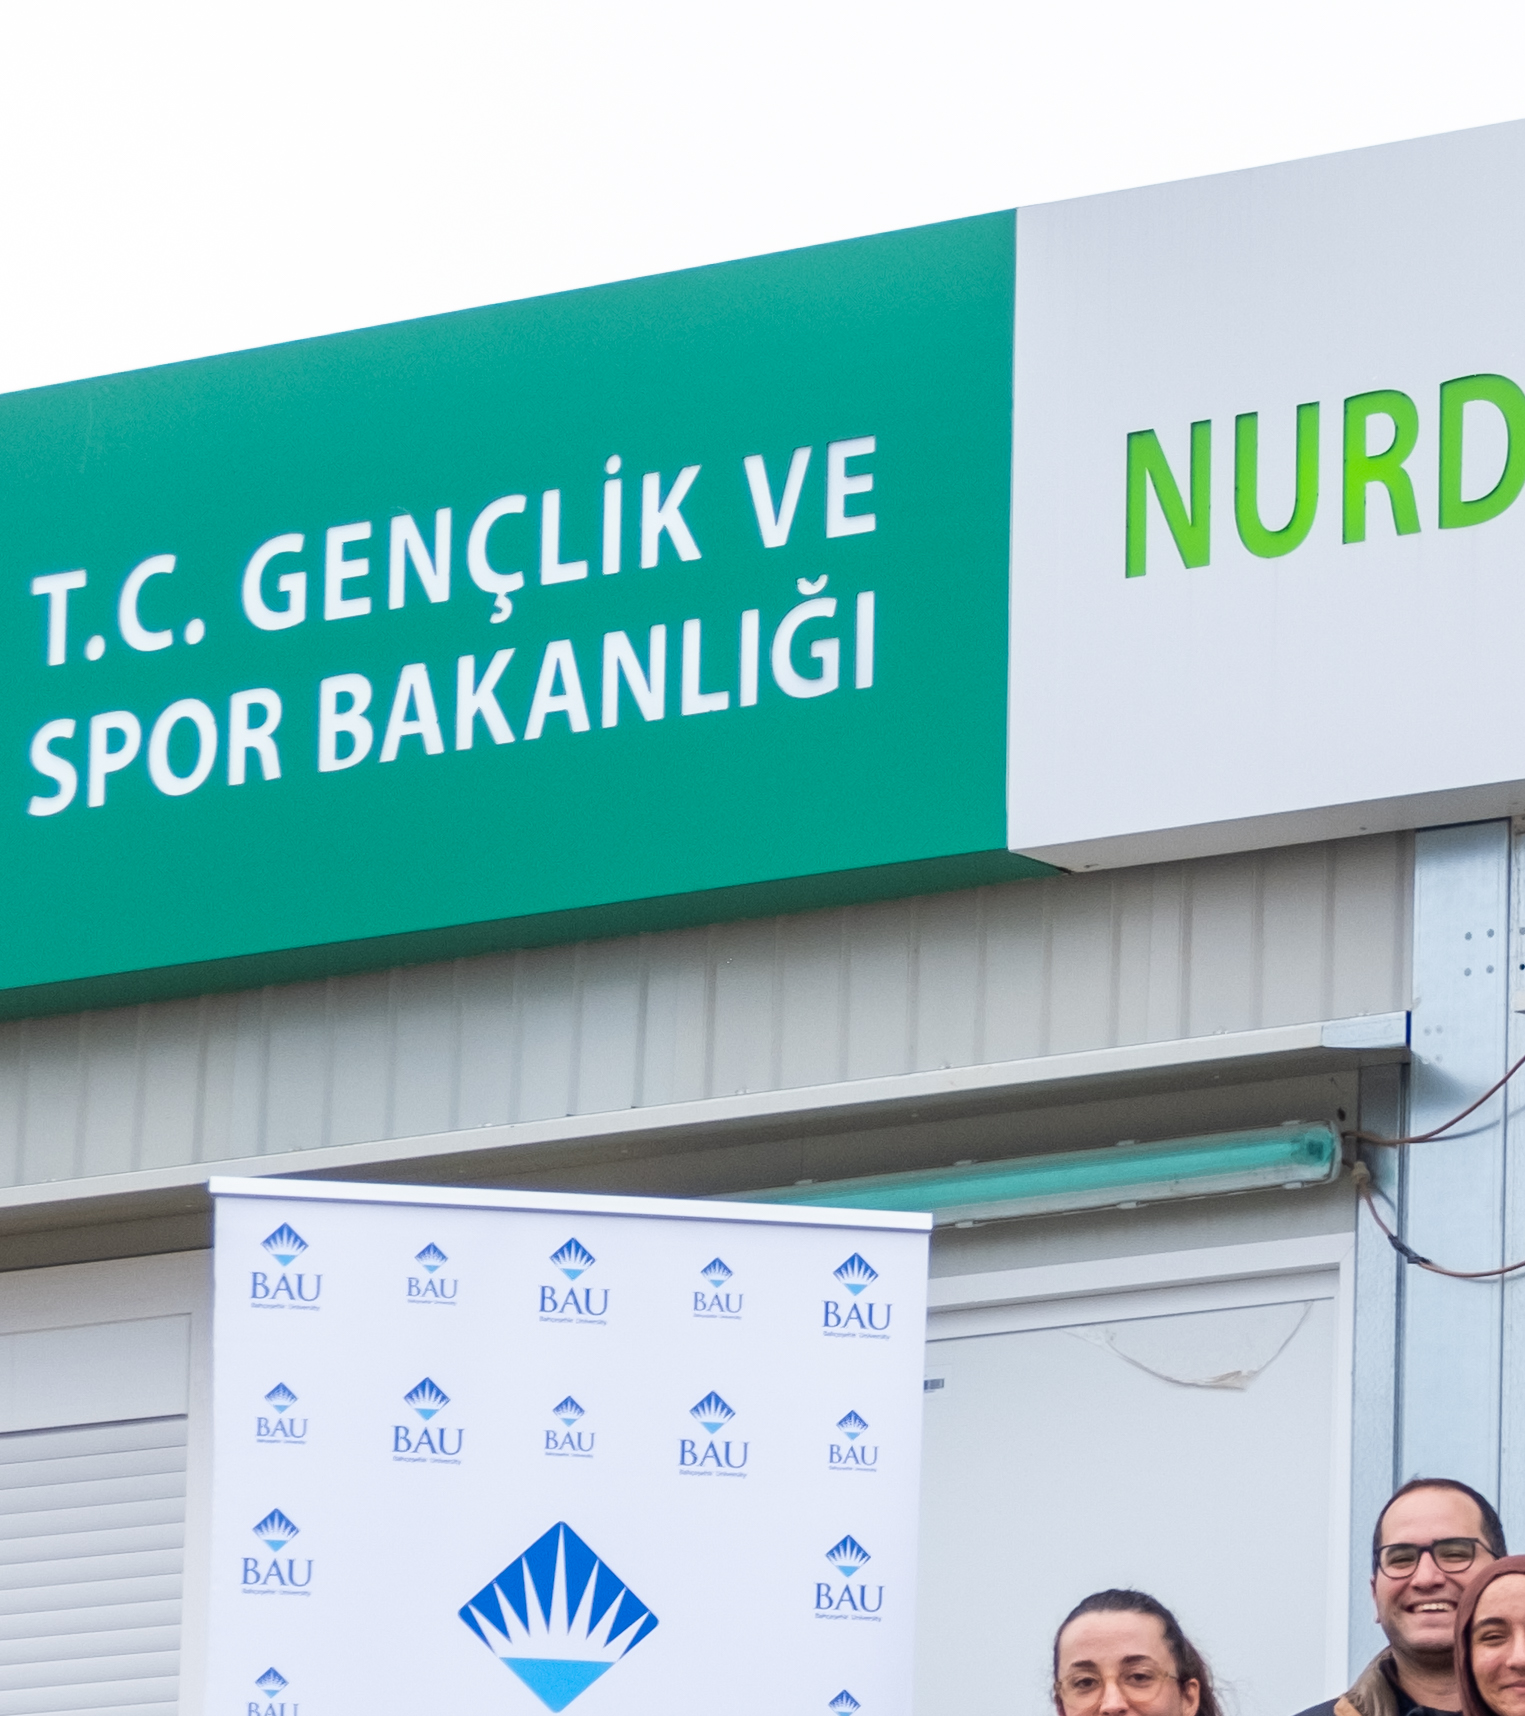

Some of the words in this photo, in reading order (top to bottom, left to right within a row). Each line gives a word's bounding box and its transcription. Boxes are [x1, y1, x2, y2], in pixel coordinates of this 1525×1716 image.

[31, 553, 205, 667] T.C.
[242, 454, 702, 631] GENÇLİK
[744, 435, 876, 549] VE
[28, 687, 282, 817] SPOR
[318, 573, 875, 773] BAKANLIĞI
[249, 1271, 324, 1303] BAU
[405, 1276, 459, 1300] BAU
[538, 1284, 611, 1317] BAU
[692, 1290, 745, 1314] BAU
[821, 1299, 893, 1331] BAU
[255, 1416, 309, 1439] BAU
[391, 1424, 466, 1456] BAU
[543, 1429, 596, 1453] BAU
[677, 1438, 750, 1469] BAU
[828, 1443, 880, 1467] BAU
[240, 1556, 315, 1588] BAU
[813, 1582, 886, 1613] BAU
